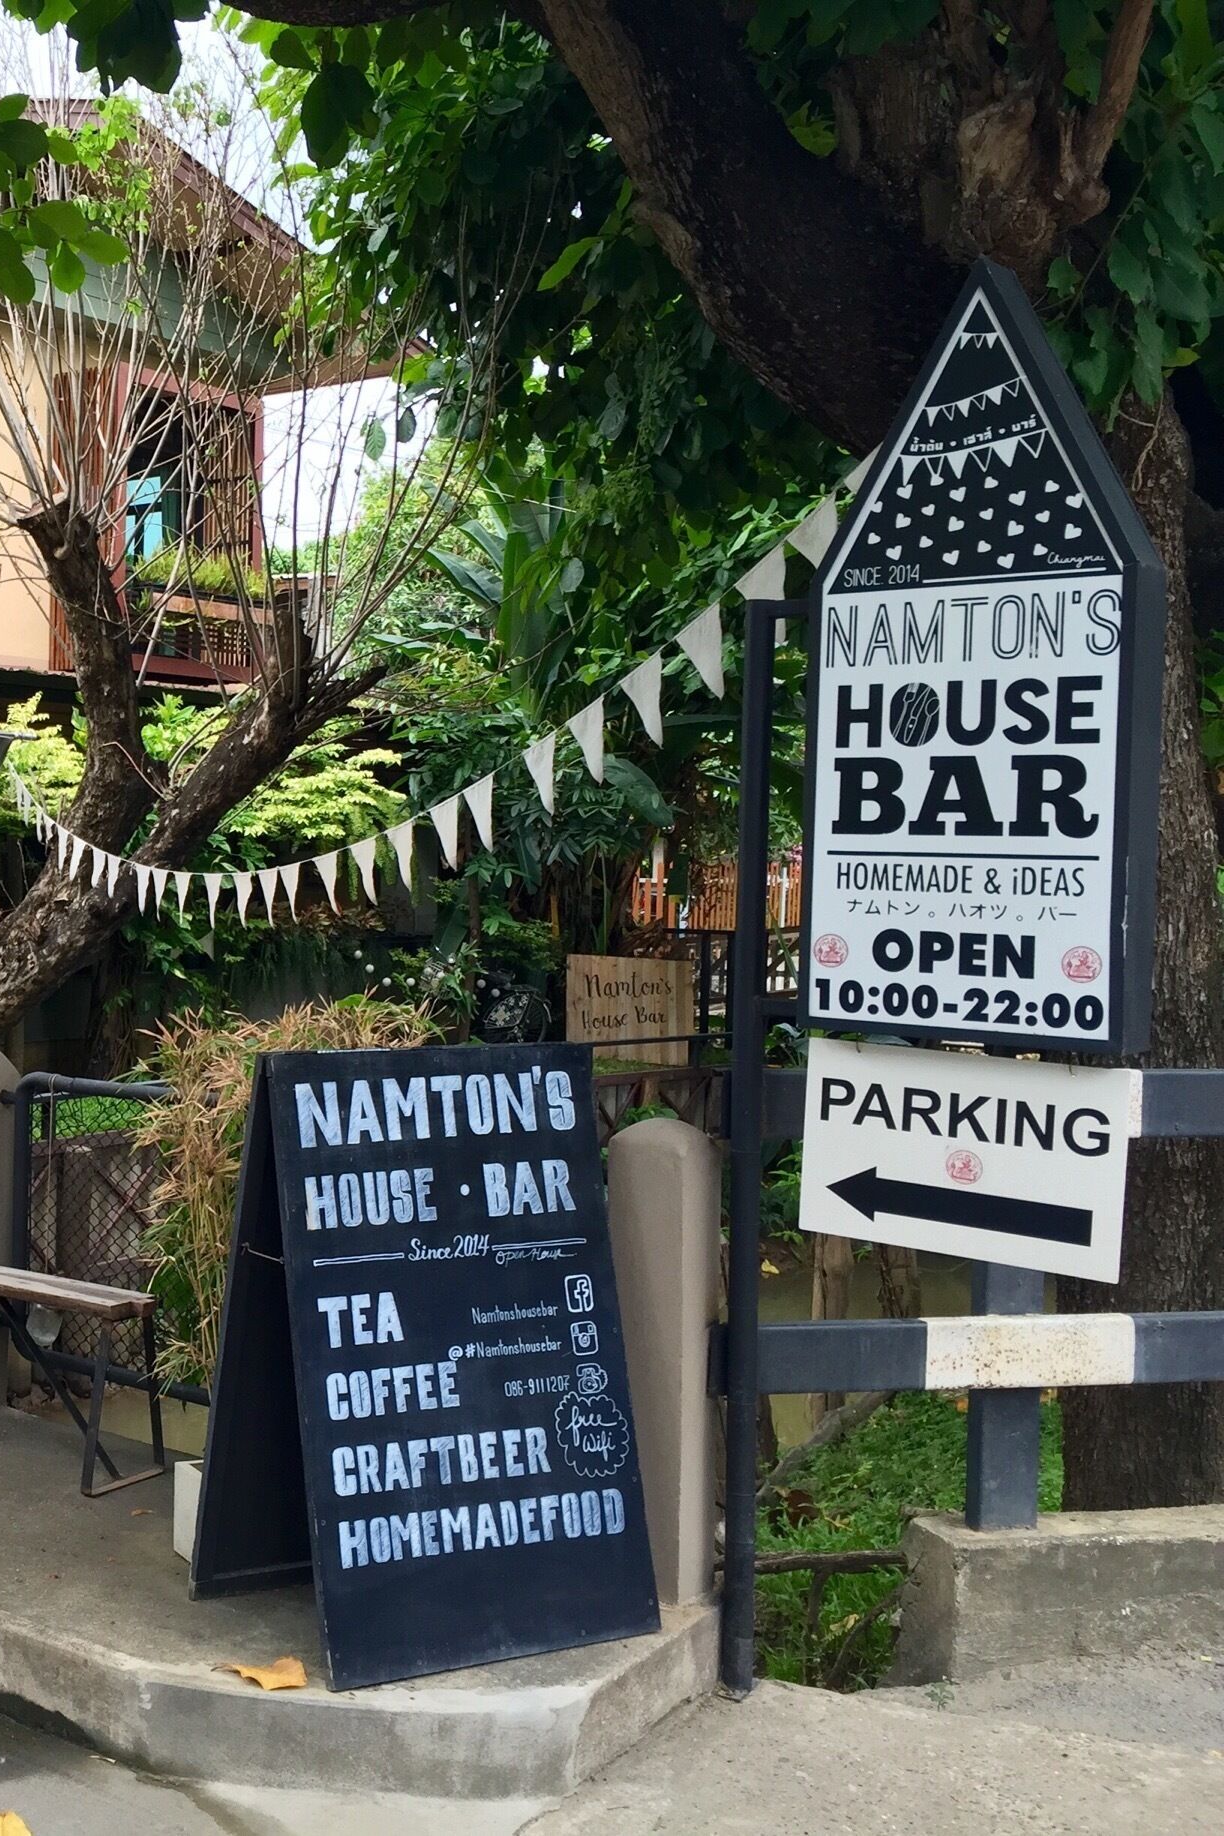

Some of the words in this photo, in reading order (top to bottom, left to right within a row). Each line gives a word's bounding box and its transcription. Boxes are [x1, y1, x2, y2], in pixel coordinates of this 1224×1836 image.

[888, 563, 920, 585] 2014
[826, 588, 1122, 668] NAMTON'S
[835, 675, 1103, 748] HOUSE
[831, 754, 1100, 839] BAR
[837, 862, 973, 894] HOMEMADE
[983, 868, 1002, 895] &
[872, 928, 1036, 980] OPEN
[585, 972, 672, 998] Namton's
[814, 978, 1104, 1031] 10:00-22:00
[582, 1010, 628, 1030] House
[634, 1006, 667, 1024] Bar
[294, 1065, 576, 1149] NAMTON'S
[820, 1077, 1111, 1157] PARKING
[304, 1168, 437, 1231] HOUSE
[483, 1158, 576, 1218] BAR
[317, 1291, 405, 1349] TEA
[471, 1300, 559, 1325] Namtonshousebar
[326, 1360, 461, 1421] COFFEE
[504, 1375, 570, 1397] 086-9111207
